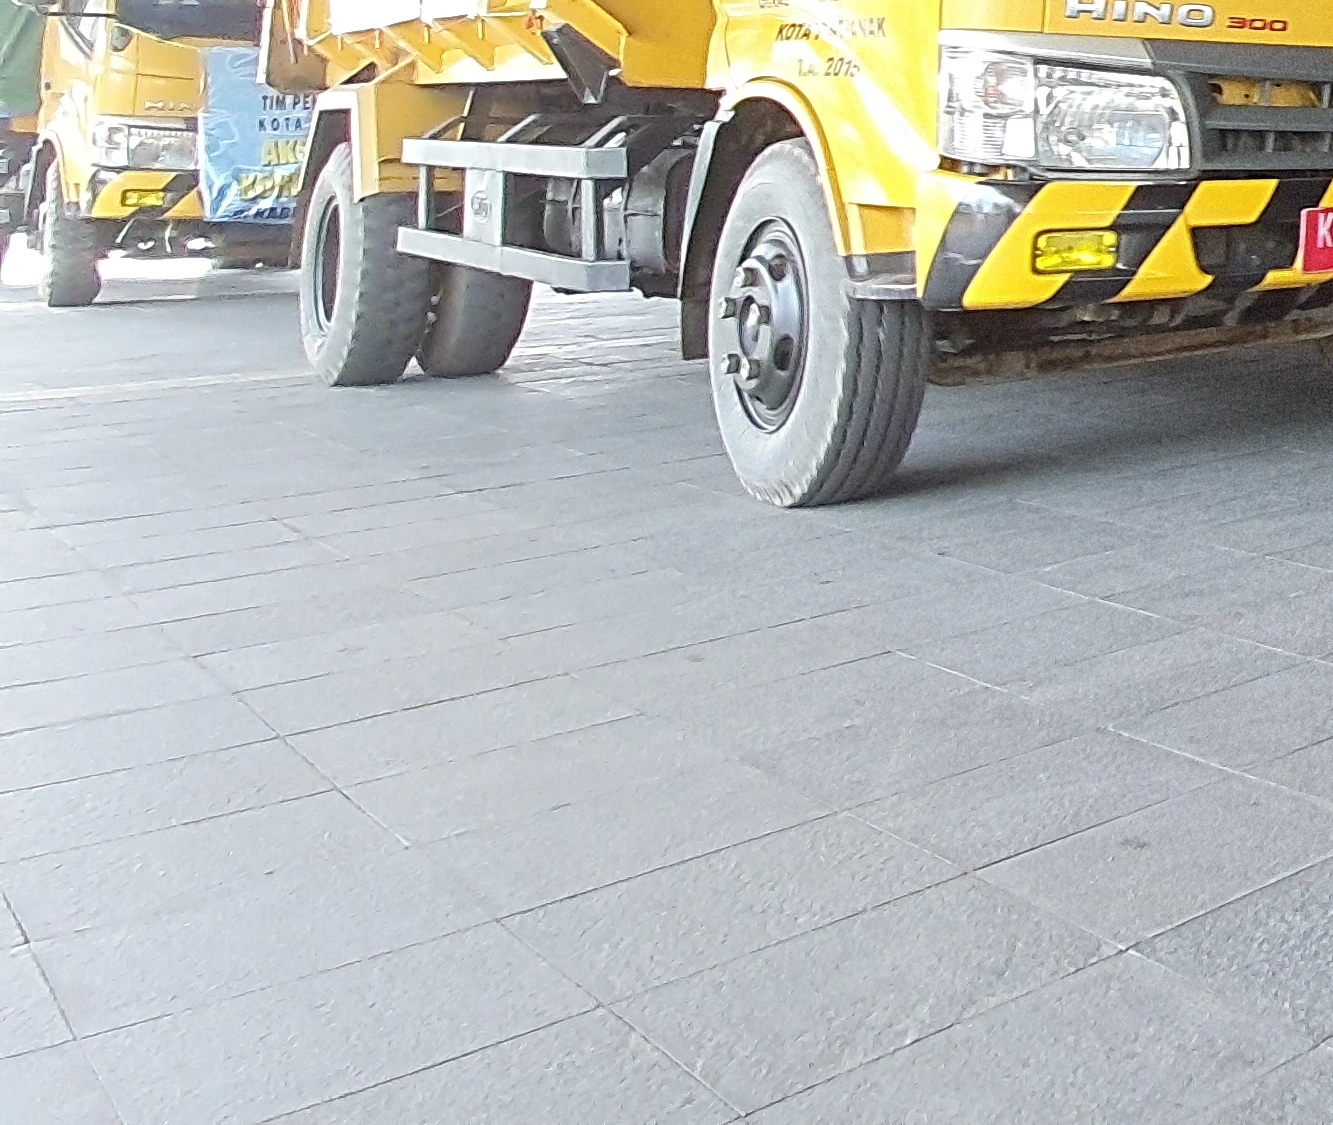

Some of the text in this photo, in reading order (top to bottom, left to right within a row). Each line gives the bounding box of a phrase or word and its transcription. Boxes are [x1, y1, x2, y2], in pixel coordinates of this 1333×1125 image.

[775, 22, 811, 41] KOTA
[1227, 16, 1288, 32] 300
[261, 94, 315, 111] TIM PE
[258, 117, 303, 132] KOTA
